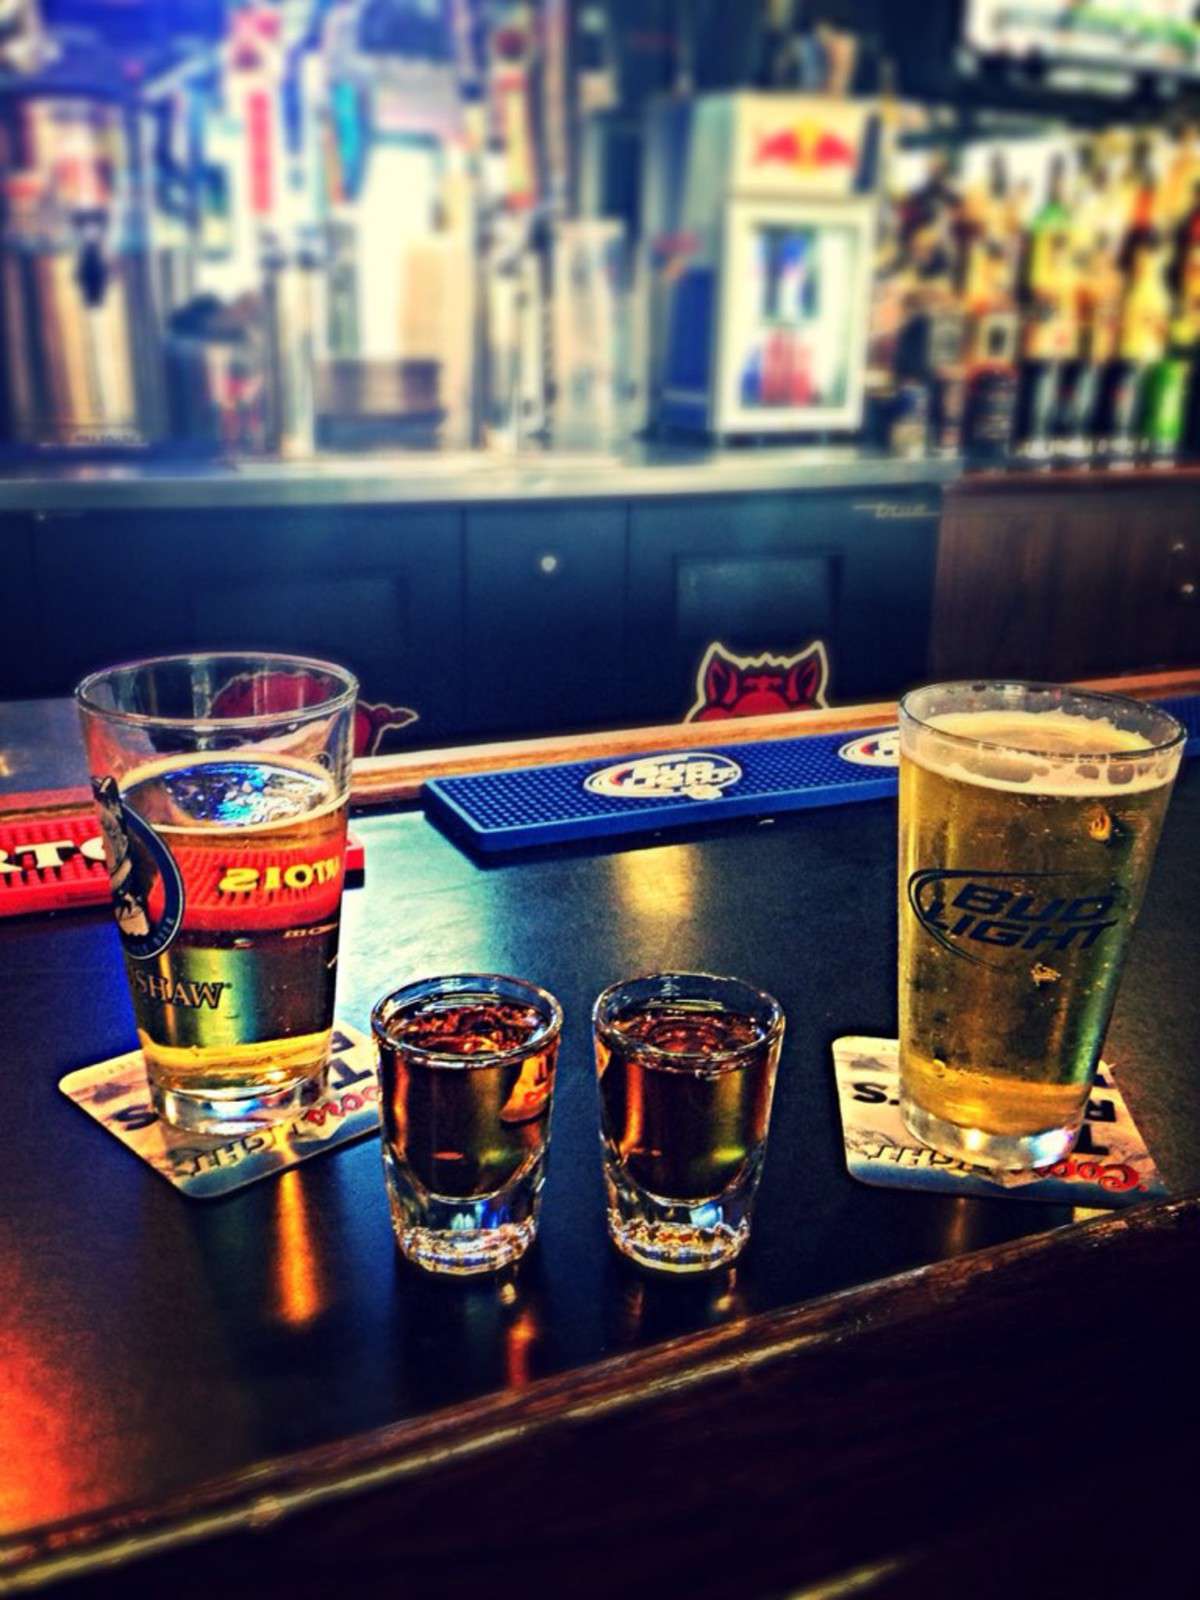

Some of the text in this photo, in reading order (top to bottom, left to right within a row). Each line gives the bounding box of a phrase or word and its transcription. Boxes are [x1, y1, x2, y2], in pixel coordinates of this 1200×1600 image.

[951, 882, 1117, 923] BUD
[922, 900, 1119, 951] LIGHT
[301, 1086, 382, 1127] oors
[1011, 1160, 1148, 1192] Coo
